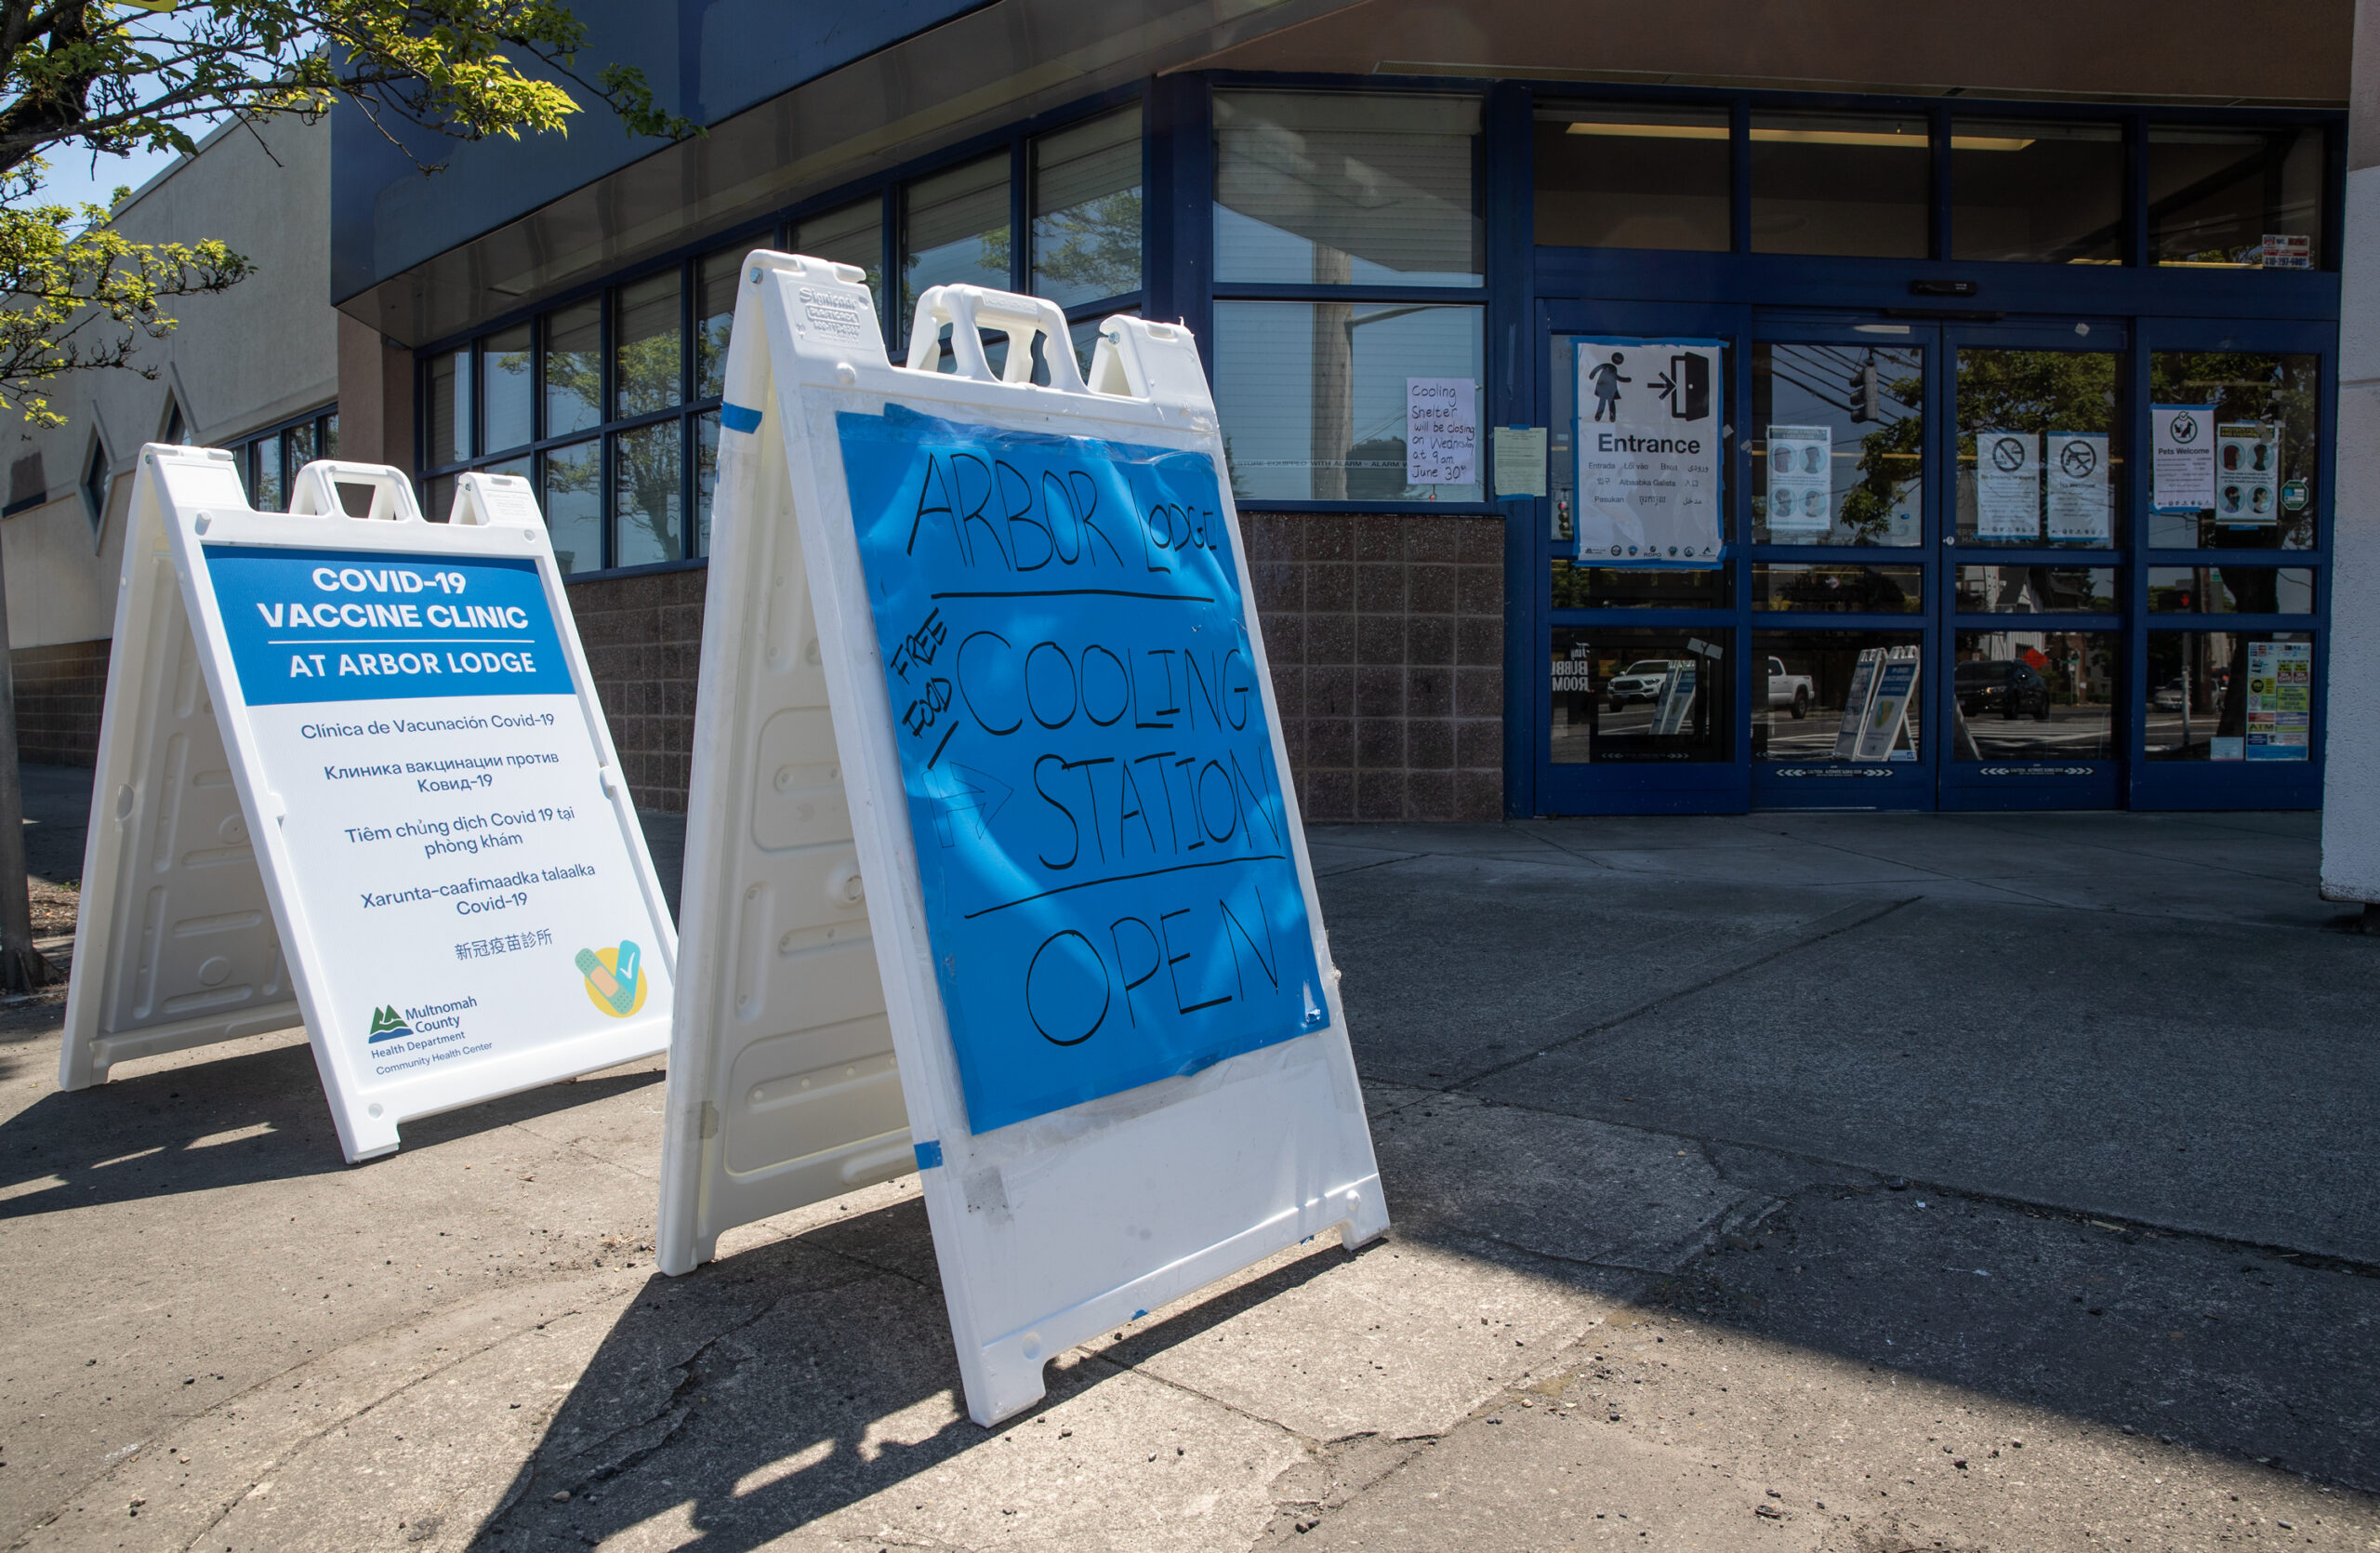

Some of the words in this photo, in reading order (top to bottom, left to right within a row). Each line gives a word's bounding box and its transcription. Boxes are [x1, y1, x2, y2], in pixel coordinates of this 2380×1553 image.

[1411, 383, 1457, 407] Cooling
[1411, 405, 1458, 419] Shelter
[1413, 421, 1429, 432] will
[1433, 422, 1445, 433] be
[1448, 423, 1475, 442] closing
[1598, 433, 1701, 455] Entrance
[1412, 435, 1425, 445] on
[1430, 436, 1474, 456] Wednesday
[1412, 451, 1427, 460] at
[1311, 459, 1331, 468] WITH
[1334, 459, 1363, 468] ALARM
[1371, 459, 1400, 469] ALARM
[1411, 465, 1438, 479] June
[1588, 461, 1616, 470] Entrada
[907, 451, 1124, 572] ARBOR
[1594, 495, 1625, 503] Pasukan
[312, 567, 467, 594] COVID-19
[257, 602, 423, 629] VACCINE
[427, 605, 529, 630] CLINIC
[890, 607, 948, 685] FREE
[289, 654, 326, 678] AT
[338, 653, 440, 677] ARBOR
[448, 652, 536, 674] LODGE
[957, 630, 1250, 737] COOLING
[901, 676, 954, 740] FOOD
[300, 721, 364, 740] Clínica
[367, 719, 390, 736] de
[393, 715, 488, 735] Vacunación
[491, 713, 555, 728] Covid-19
[324, 761, 403, 781] Клиника
[405, 755, 503, 775] вакцинации
[506, 751, 560, 770] против
[416, 775, 493, 793] Ковид-19
[1034, 745, 1282, 871] STATION
[345, 825, 392, 844] Tiêm
[395, 816, 450, 841] chủng
[453, 815, 488, 837] dịch
[490, 810, 536, 829] Covid
[537, 808, 553, 824] 19
[555, 805, 575, 823] tại
[424, 836, 478, 859] phòng
[481, 831, 522, 852] khám
[361, 870, 541, 909] Xarunta-caafimaadka
[542, 863, 596, 883] talaalka
[456, 892, 528, 916] Covid-19
[454, 928, 554, 962] 新冠疫苗診所
[1025, 885, 1280, 1047] OPEN
[404, 995, 478, 1022] Multnomah
[415, 1015, 461, 1036] County
[371, 1042, 405, 1060] Health
[406, 1030, 466, 1054] Department
[376, 1055, 430, 1076] Community
[431, 1050, 462, 1065] Health
[462, 1042, 494, 1058] Center
